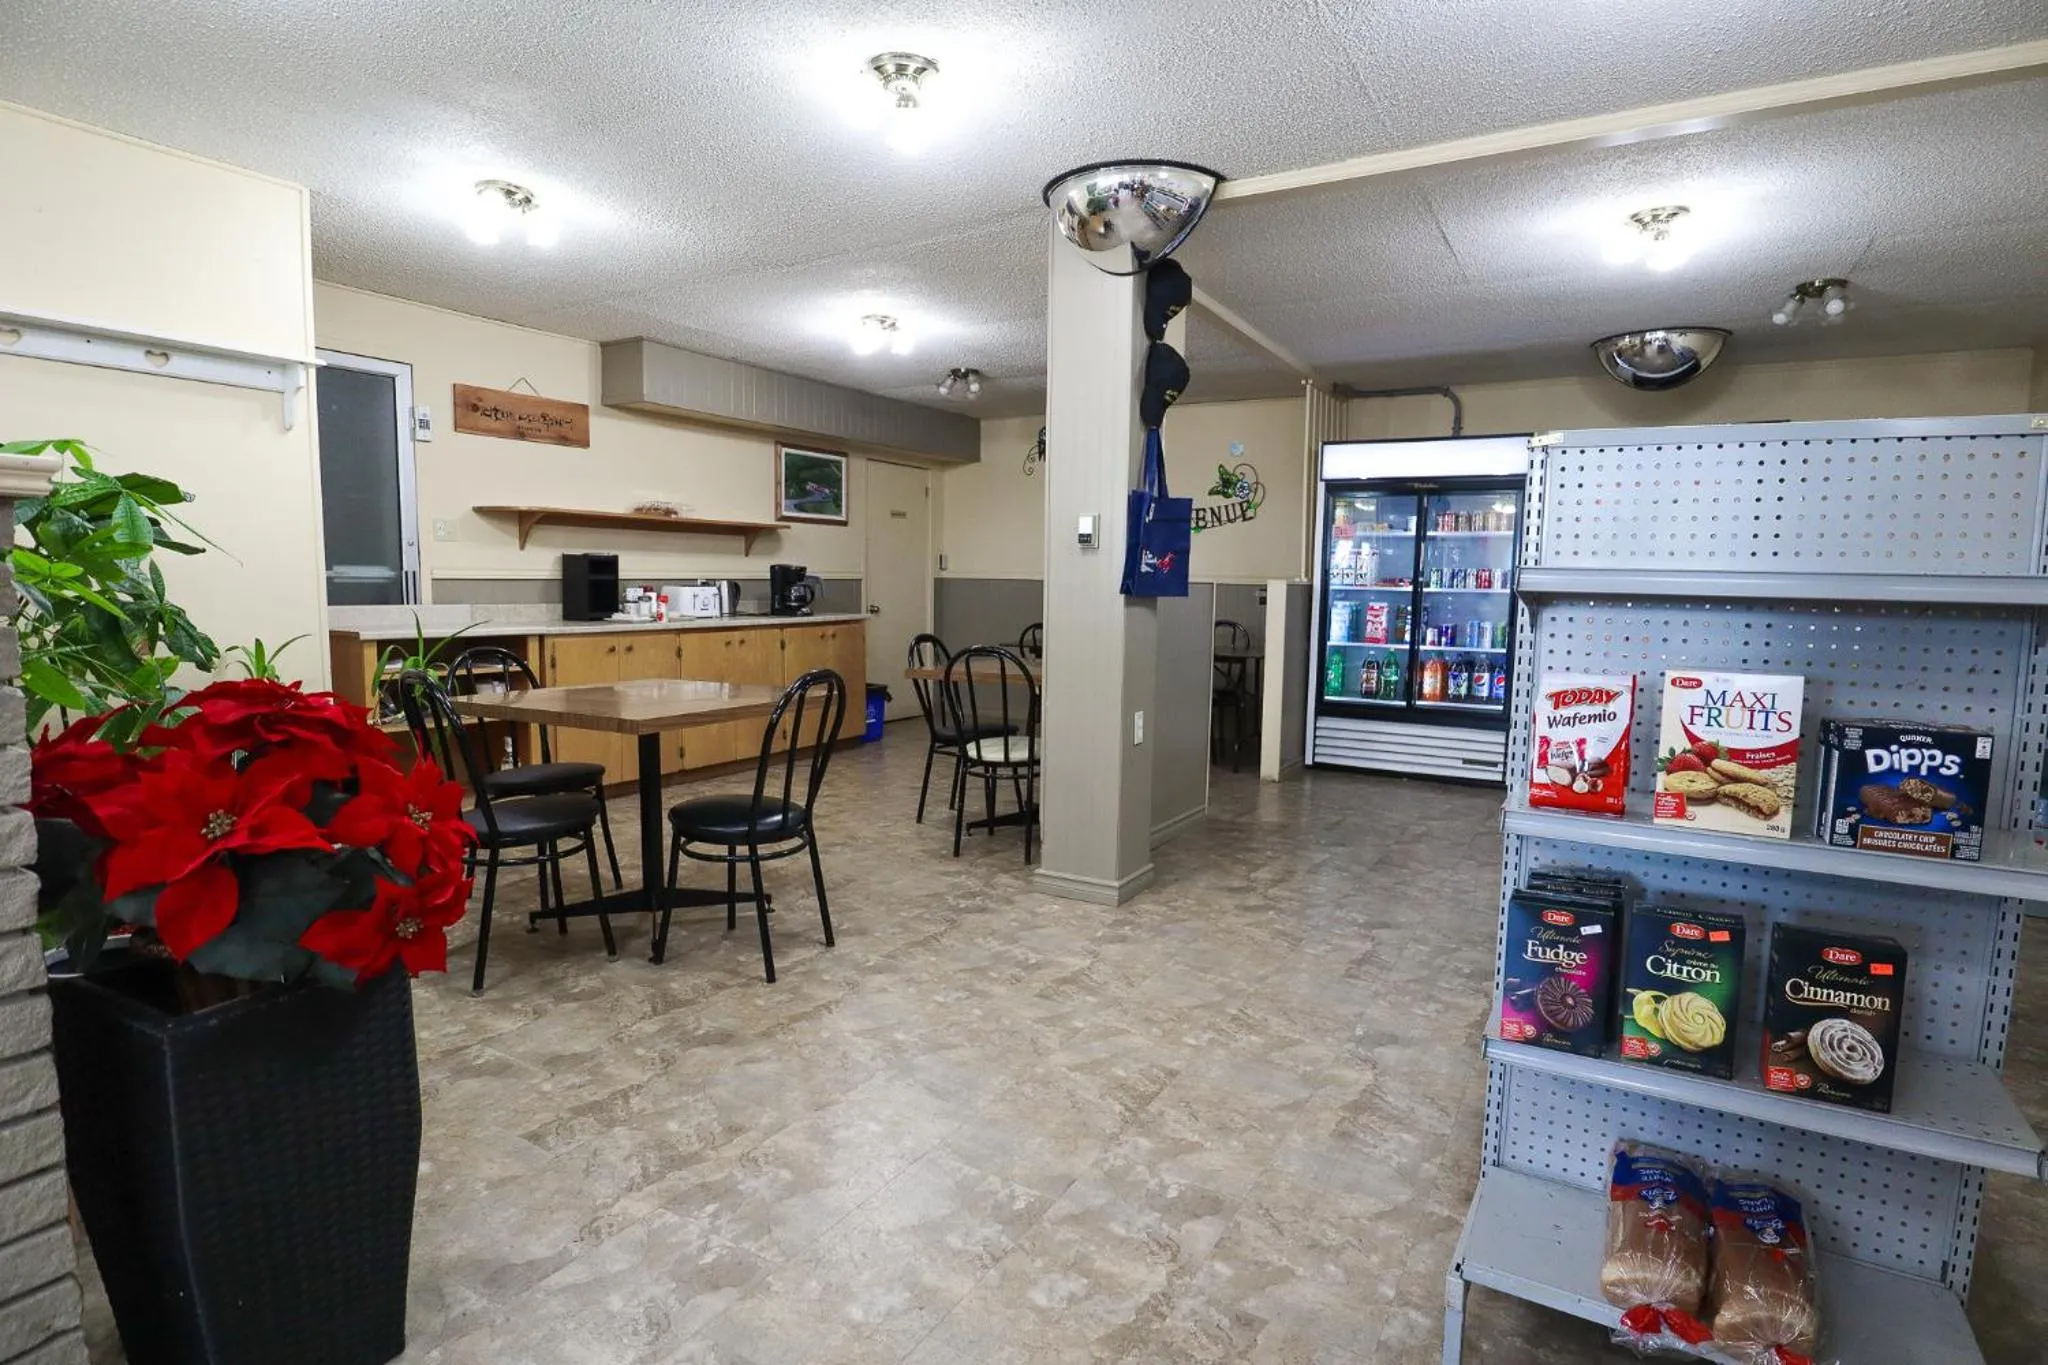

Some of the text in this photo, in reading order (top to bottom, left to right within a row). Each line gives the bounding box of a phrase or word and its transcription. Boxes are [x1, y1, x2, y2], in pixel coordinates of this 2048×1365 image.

[1192, 501, 1256, 529] ENUE
[1676, 678, 1698, 687] Dare
[1546, 688, 1624, 710] TODAY
[1704, 689, 1778, 710] MAXI
[1547, 709, 1618, 729] Wafemio
[1688, 705, 1793, 733] FRUITS
[1900, 734, 1934, 744] QUAKER
[1865, 744, 1962, 776] Dipps
[1547, 912, 1570, 922] Dare
[1676, 926, 1700, 936] Dare
[1526, 939, 1588, 968] Fudge
[1828, 950, 1857, 961] Dare
[1646, 955, 1722, 983] Citron
[1785, 977, 1891, 1011] Cinnamon
